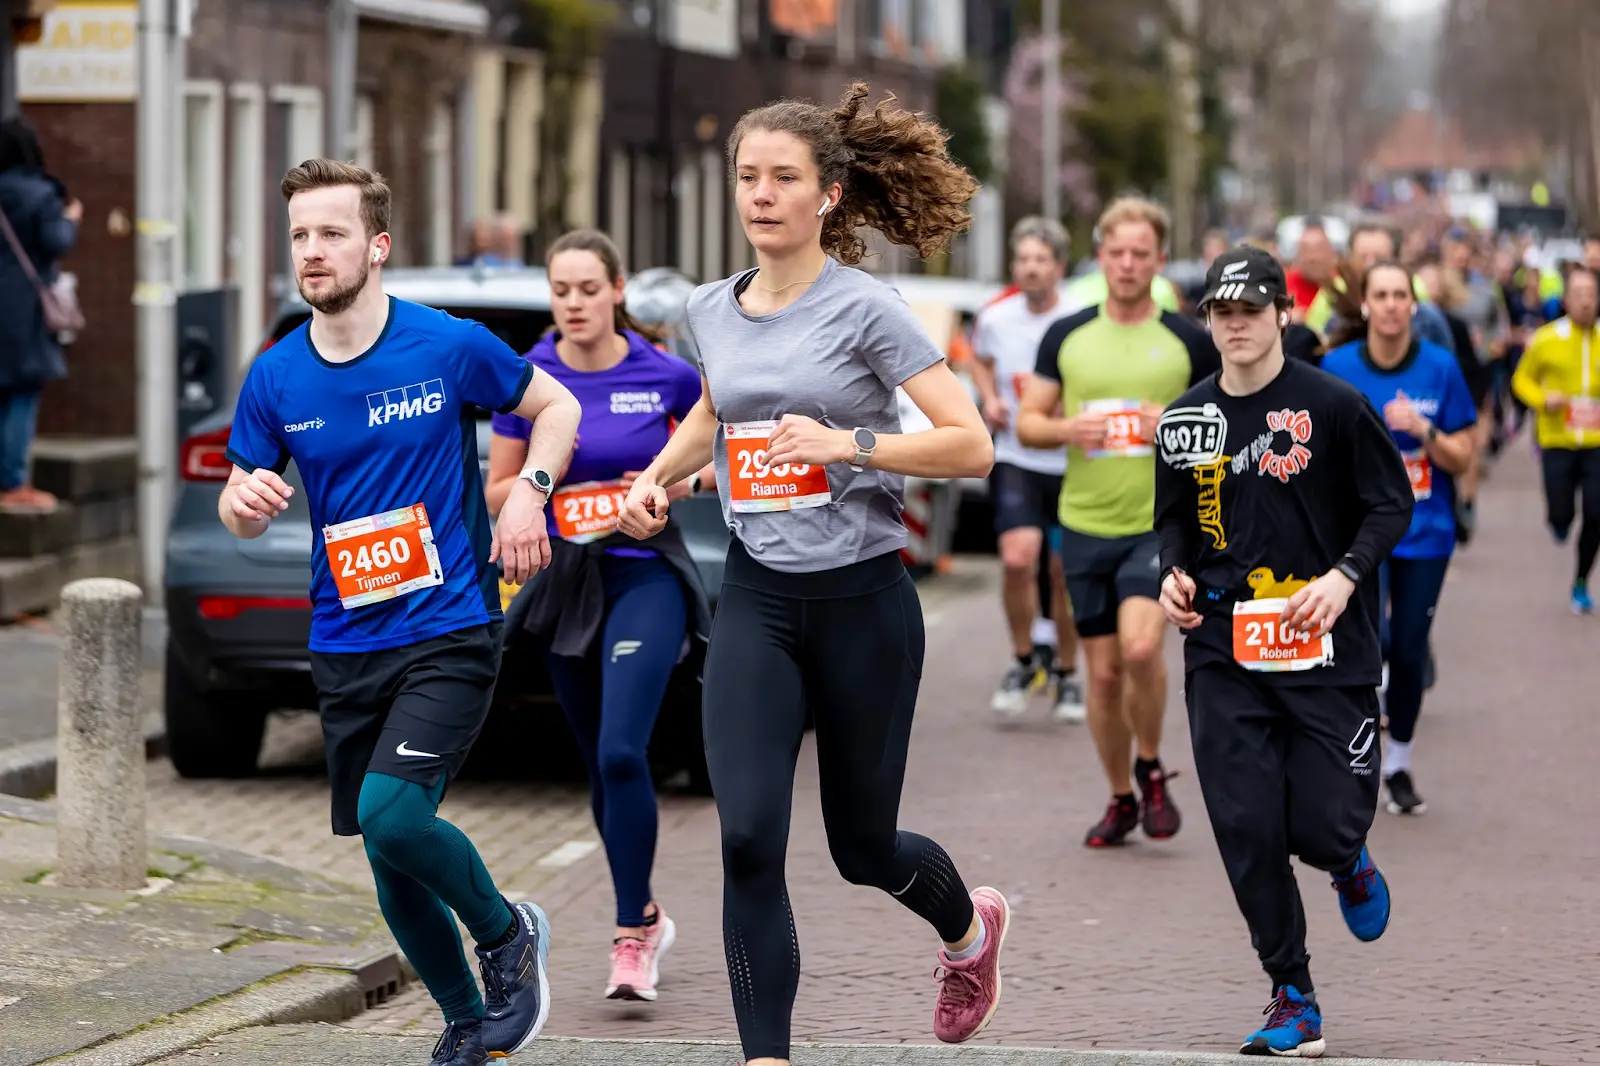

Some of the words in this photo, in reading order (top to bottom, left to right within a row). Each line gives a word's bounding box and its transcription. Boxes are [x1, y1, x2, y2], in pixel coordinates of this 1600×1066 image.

[40, 20, 136, 51] ARD
[368, 392, 443, 428] KPMG
[284, 420, 316, 433] CRAFT
[751, 482, 798, 497] Rianna
[416, 507, 427, 527] 2460
[563, 493, 624, 523] 2781
[337, 536, 411, 578] 2460
[355, 571, 402, 592] Tijmen
[1245, 620, 1311, 647] 2104
[1260, 647, 1298, 660] Robert
